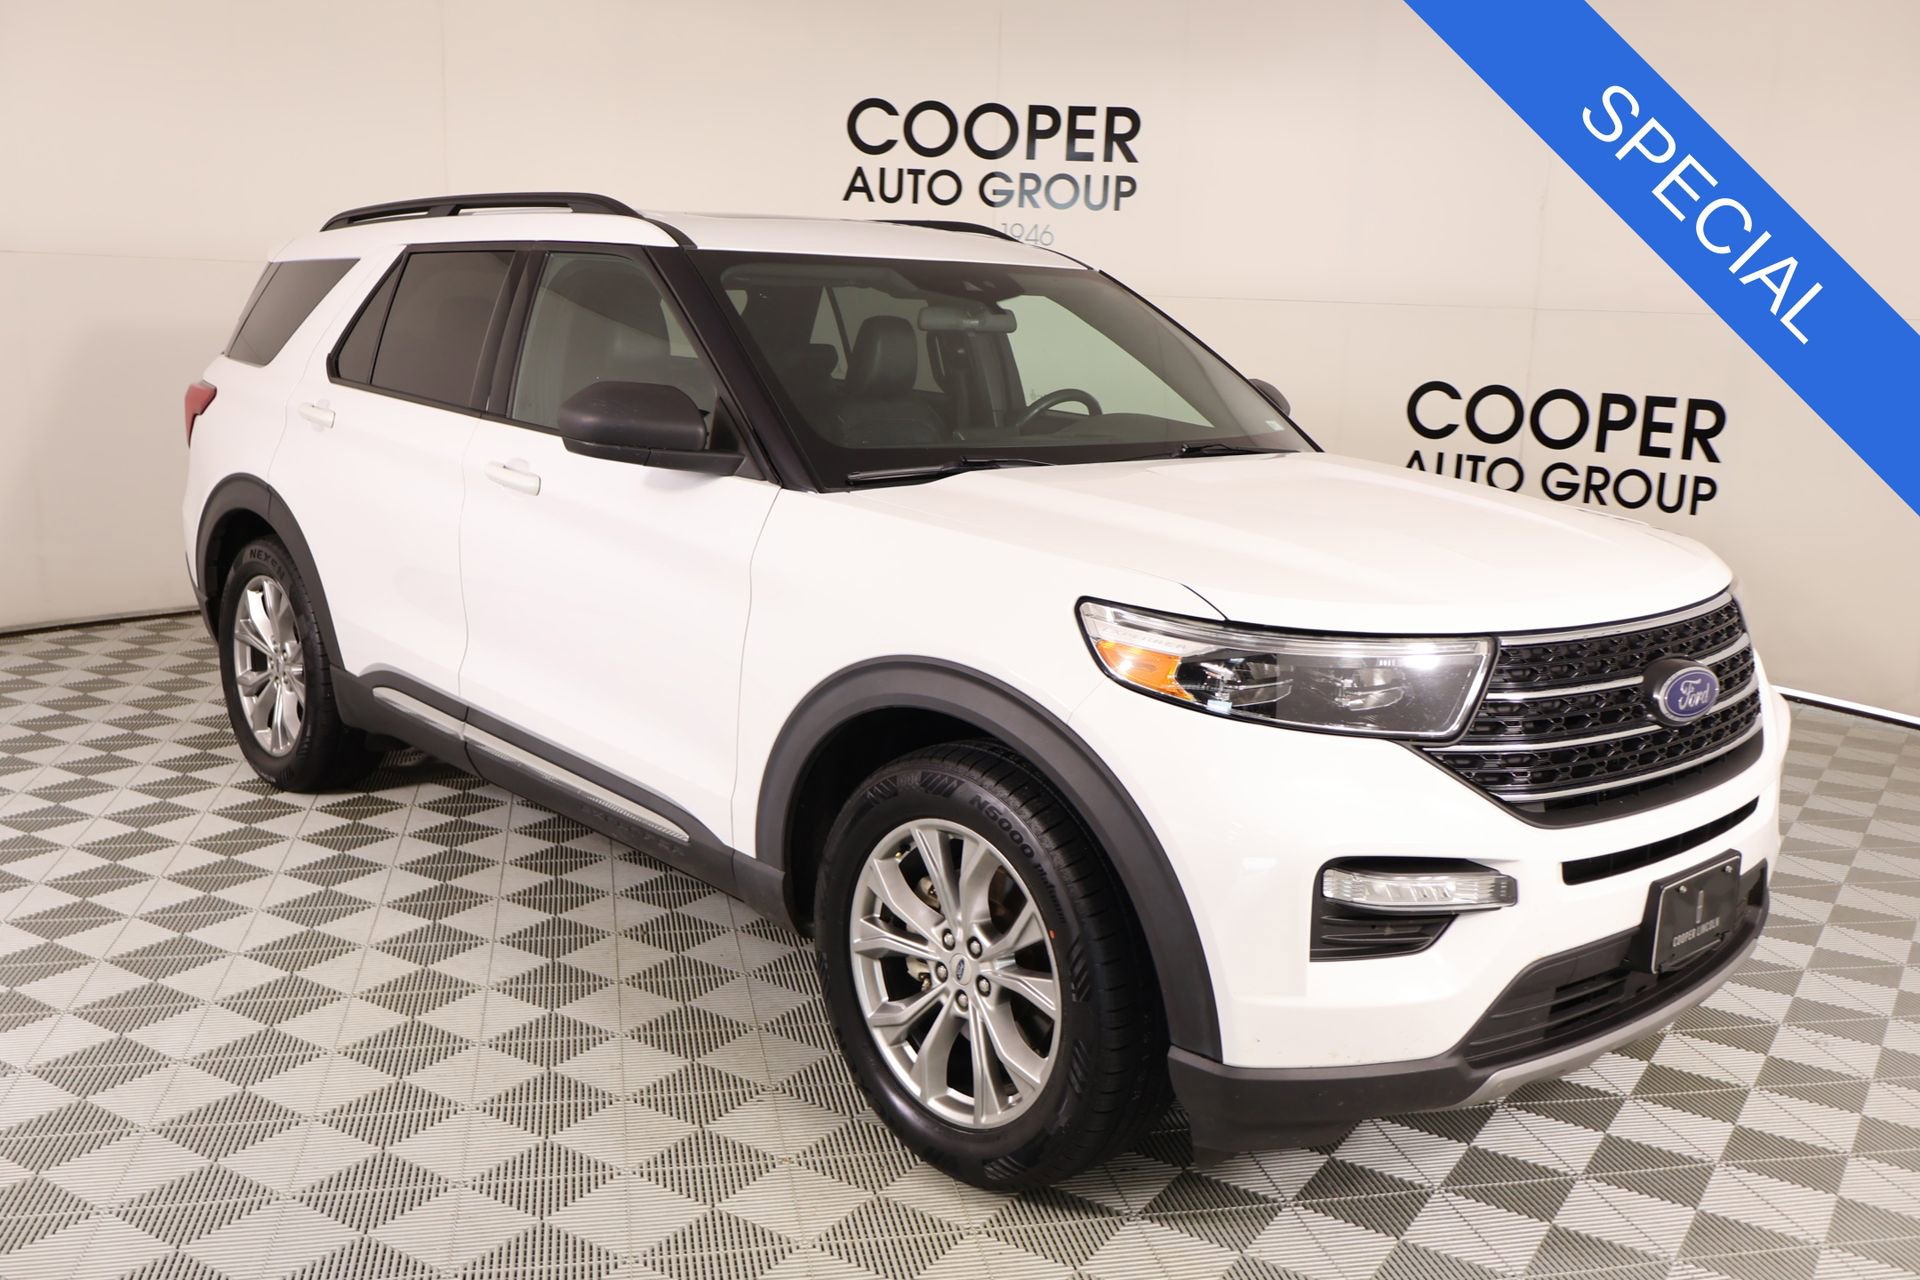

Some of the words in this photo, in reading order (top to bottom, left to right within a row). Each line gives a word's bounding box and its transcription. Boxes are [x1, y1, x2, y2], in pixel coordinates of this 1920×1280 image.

[847, 98, 1141, 163] COOPER
[843, 166, 963, 206] AUTO
[978, 171, 1137, 211] GROUP
[1407, 380, 1726, 463] COOPER
[1541, 461, 1718, 515] GROUP
[1678, 678, 1710, 710] Ford
